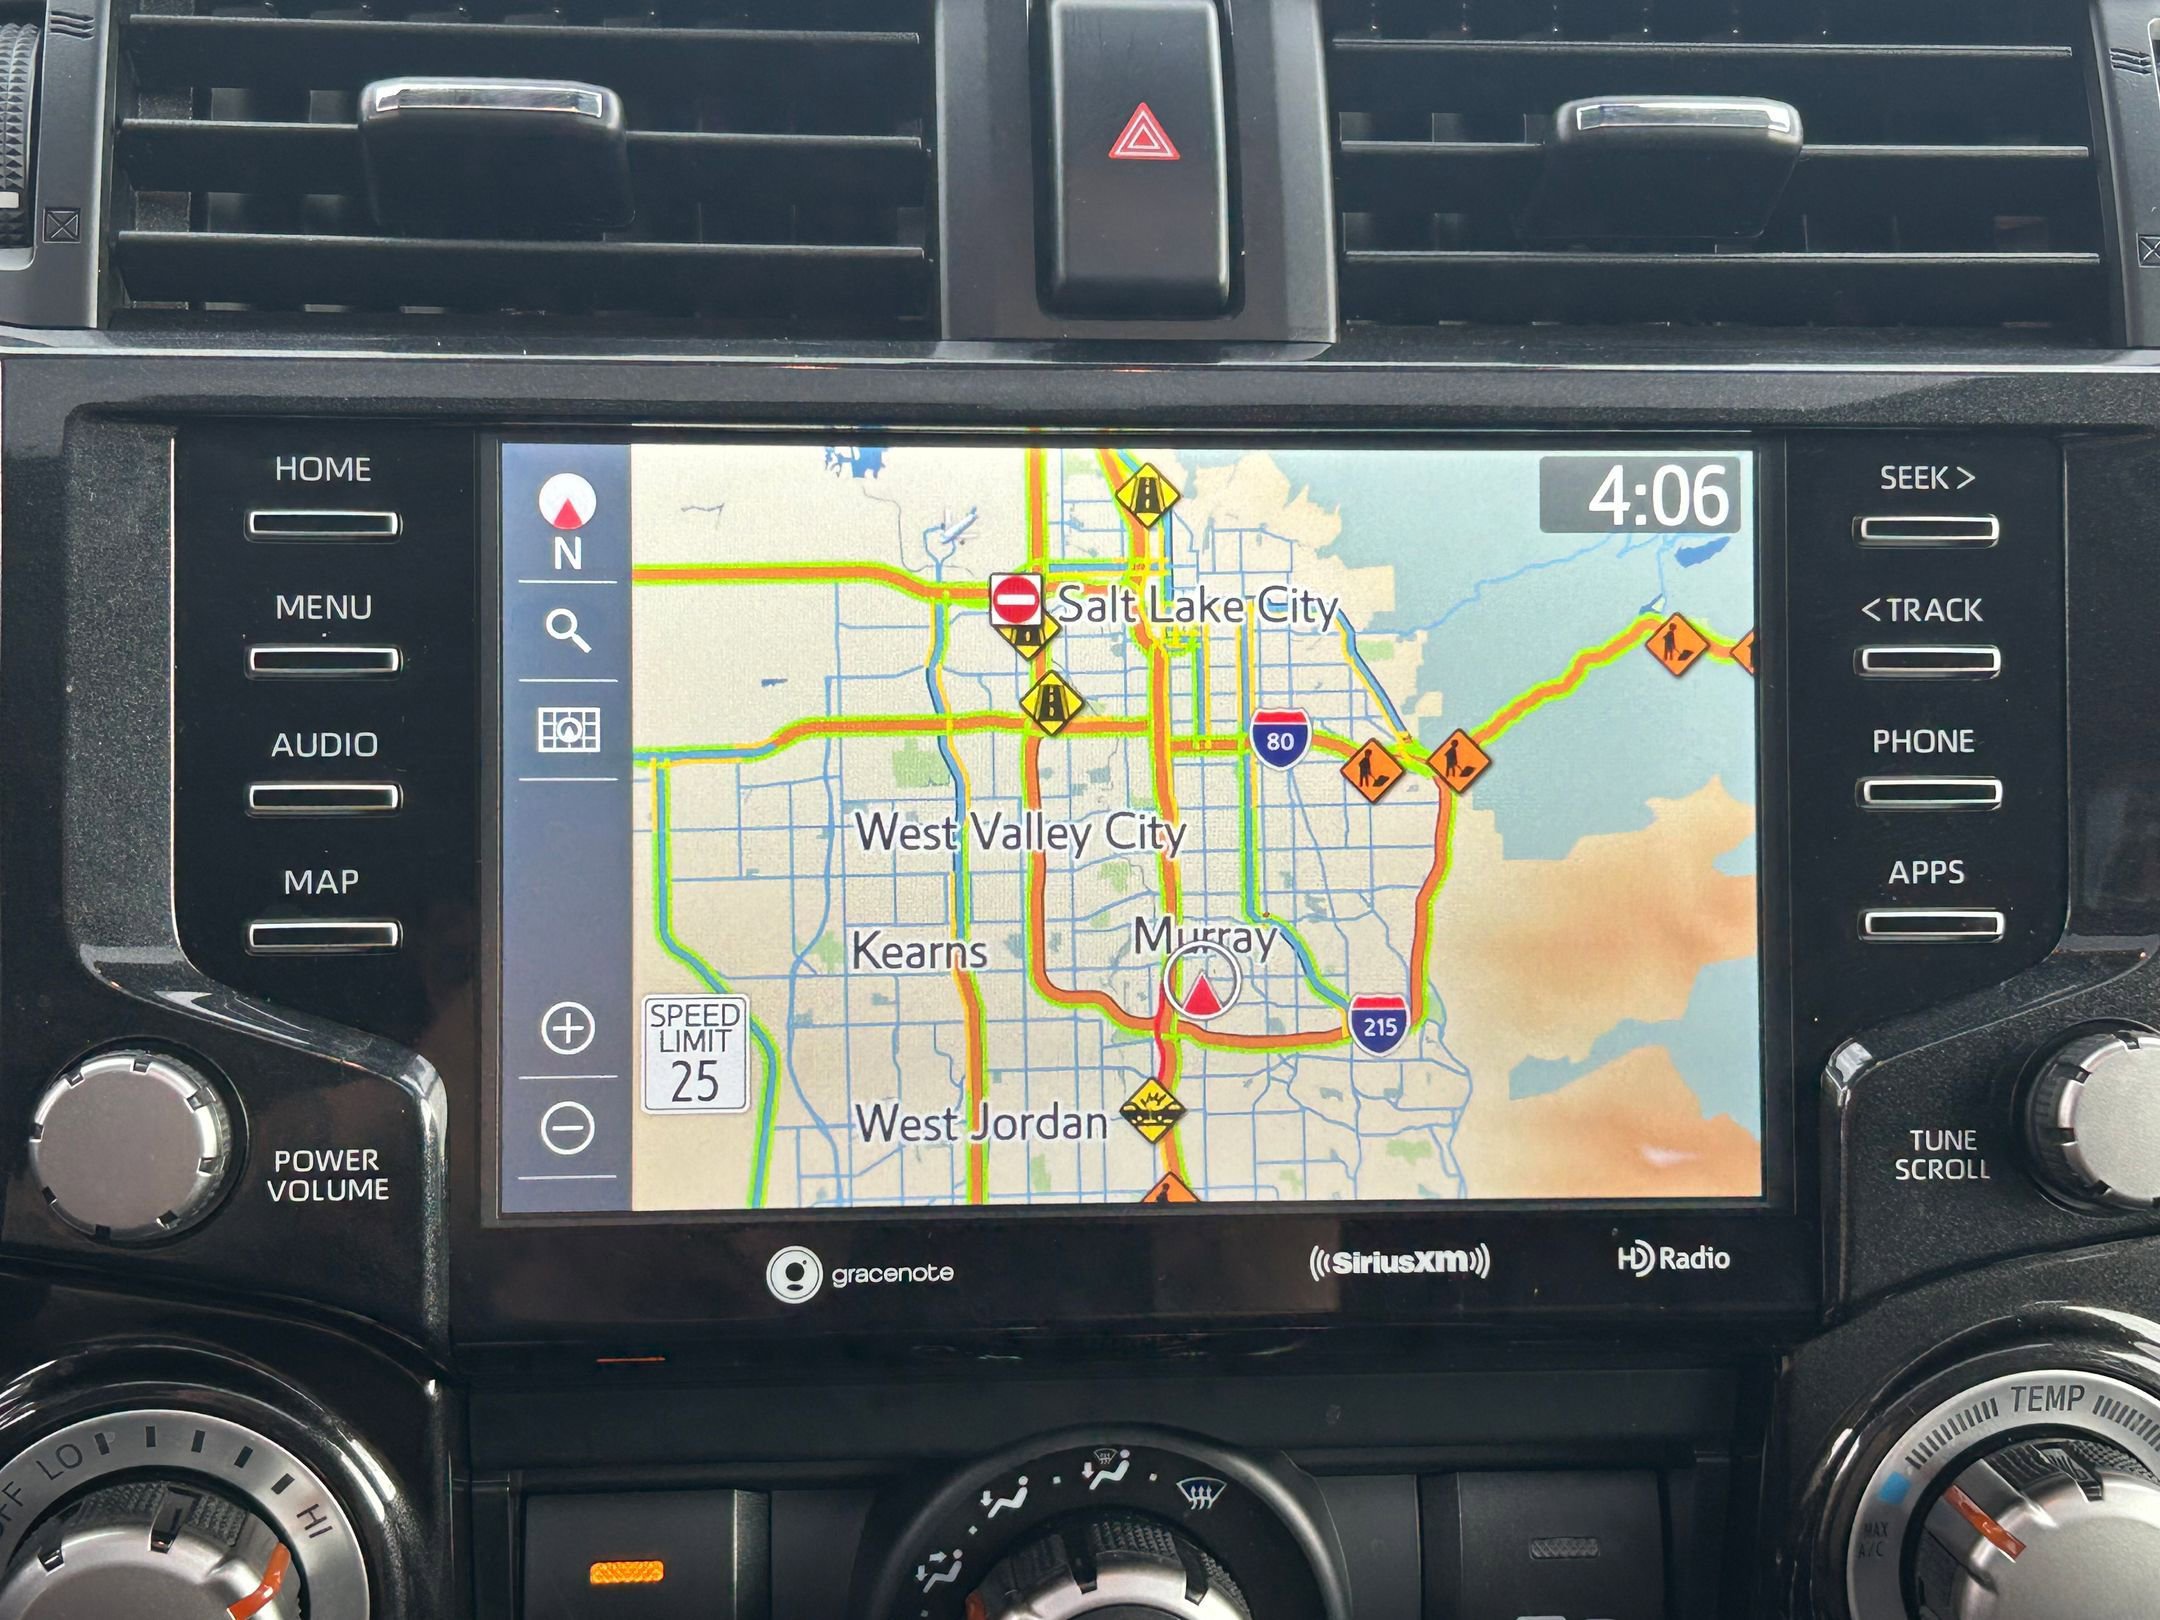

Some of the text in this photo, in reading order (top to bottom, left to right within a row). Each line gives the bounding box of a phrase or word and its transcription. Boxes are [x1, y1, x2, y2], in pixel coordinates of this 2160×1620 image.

[276, 456, 372, 482] HOME
[1588, 463, 1730, 527] 4:06
[554, 536, 582, 570] N
[276, 594, 372, 620] MENU
[1058, 584, 1339, 632] Salt Lake City
[271, 731, 378, 758] AUDIO
[1266, 732, 1295, 751] 80
[1873, 729, 1975, 754] PHONE
[855, 811, 1186, 859] West Valley City
[285, 869, 359, 895] MAP
[1888, 859, 1965, 884] APPS
[853, 930, 988, 970] Kearns
[1134, 915, 1278, 963] Murray
[649, 1003, 741, 1028] SPEED
[1364, 1017, 1398, 1037] 215
[659, 1029, 733, 1053] LIMIT
[671, 1059, 719, 1103] 25
[855, 1101, 1108, 1143] West Jordan
[1909, 1129, 1977, 1152] TUNE
[275, 1148, 380, 1173] POWER
[1895, 1158, 1991, 1181] SCROLL
[267, 1178, 390, 1202] VOLUME
[1618, 1239, 1731, 1278] HD Radio
[831, 1263, 956, 1289] gracenote
[2010, 1384, 2086, 1412] TEMP
[35, 1443, 83, 1481] LO
[295, 1503, 333, 1539] HI
